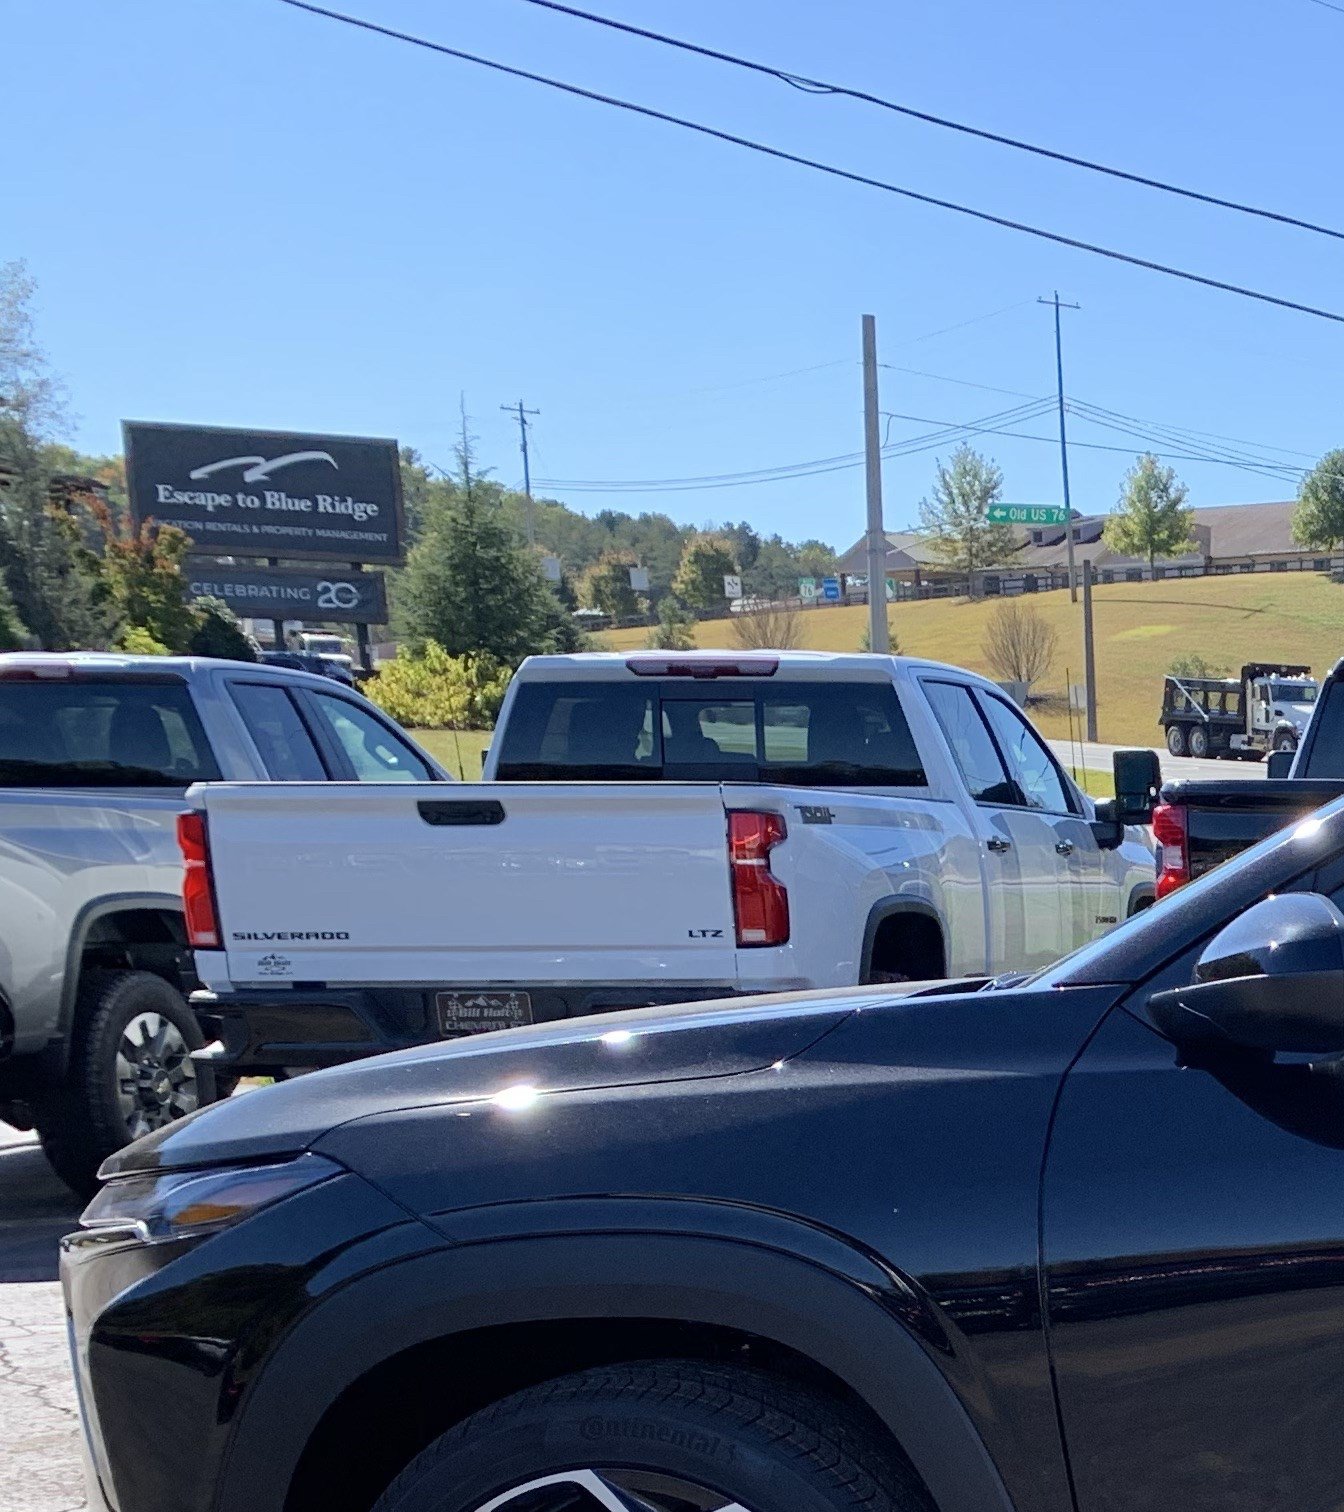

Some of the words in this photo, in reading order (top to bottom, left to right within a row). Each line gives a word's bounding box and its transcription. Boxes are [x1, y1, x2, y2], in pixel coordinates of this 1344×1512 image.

[155, 484, 232, 512] Escape
[236, 491, 260, 508] to
[263, 490, 312, 511] Blue
[315, 494, 379, 521] Ridge
[1008, 507, 1027, 521] Old
[1031, 508, 1047, 521] US
[1051, 508, 1066, 521] 76
[205, 521, 250, 533] RENTALS
[252, 524, 260, 533] &
[261, 524, 313, 537] PROPERTY
[315, 528, 388, 542] MANAGEMENT
[189, 581, 311, 601] CELEBRATING
[316, 579, 363, 609] 20
[232, 931, 350, 941] SILVERADO
[688, 929, 724, 938] LTZ
[579, 1414, 722, 1456] Continental
